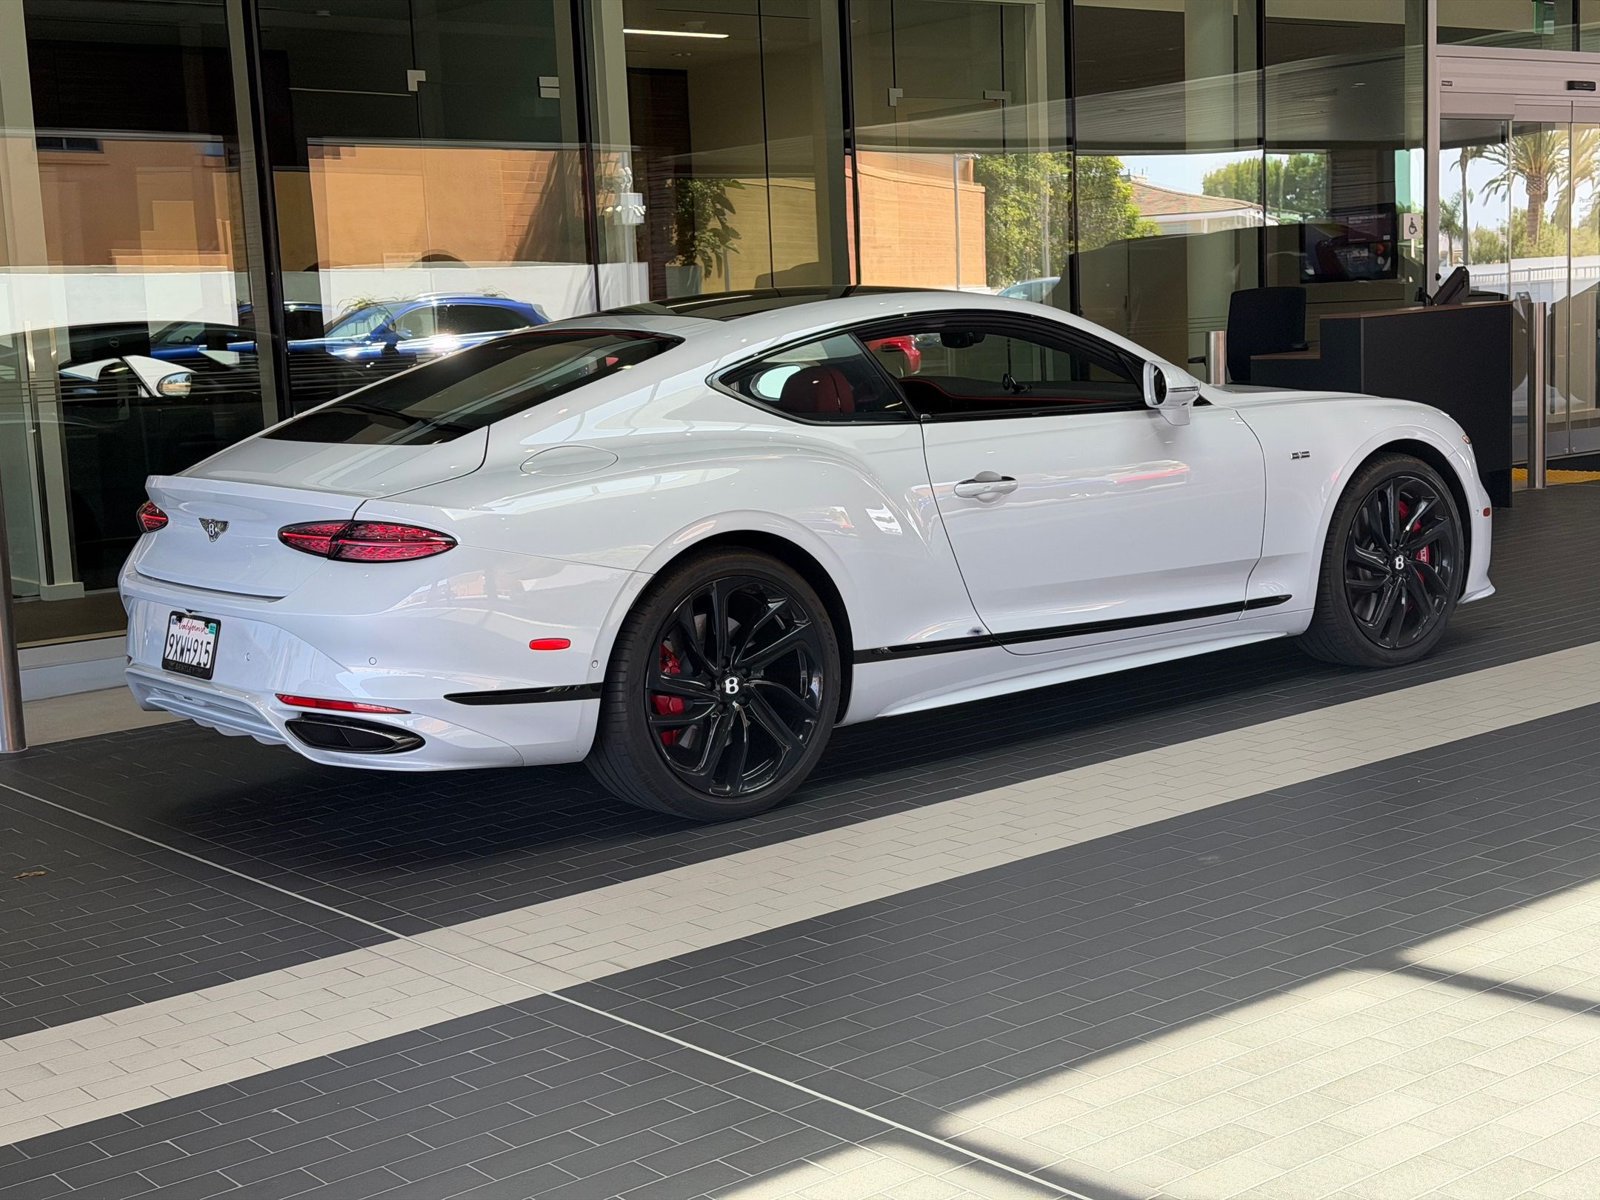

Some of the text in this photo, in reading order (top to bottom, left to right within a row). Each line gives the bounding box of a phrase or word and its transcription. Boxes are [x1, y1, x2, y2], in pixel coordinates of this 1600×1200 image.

[1395, 555, 1404, 570] B
[178, 619, 208, 635] California
[166, 633, 212, 667] 9XWH915
[725, 677, 739, 694] B
